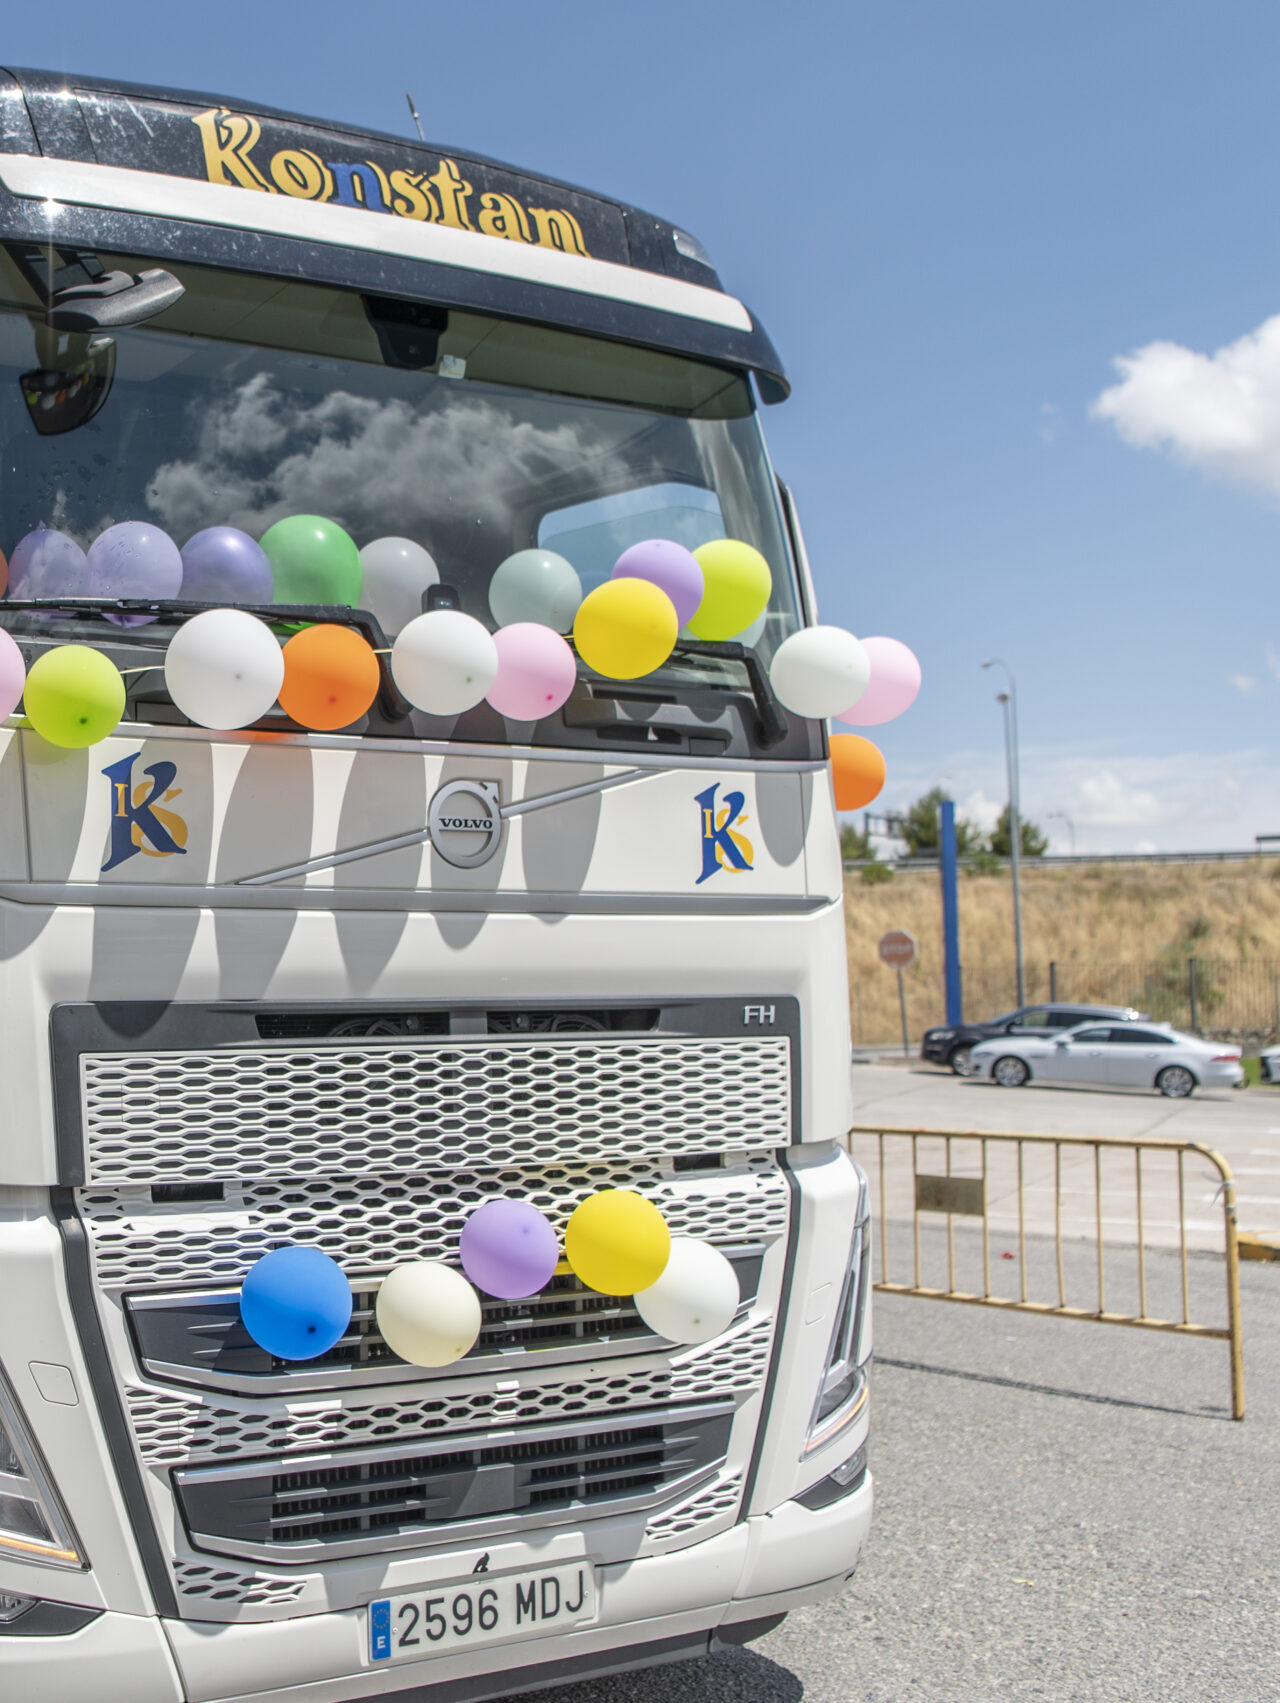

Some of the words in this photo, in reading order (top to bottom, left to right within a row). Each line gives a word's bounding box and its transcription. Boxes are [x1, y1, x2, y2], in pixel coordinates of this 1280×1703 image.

[192, 107, 591, 258] Konstan
[438, 818, 493, 829] VOLVO
[744, 1005, 776, 1024] FH
[376, 1636, 386, 1649] E
[398, 1588, 499, 1648] 2596
[516, 1570, 584, 1625] MDJ
